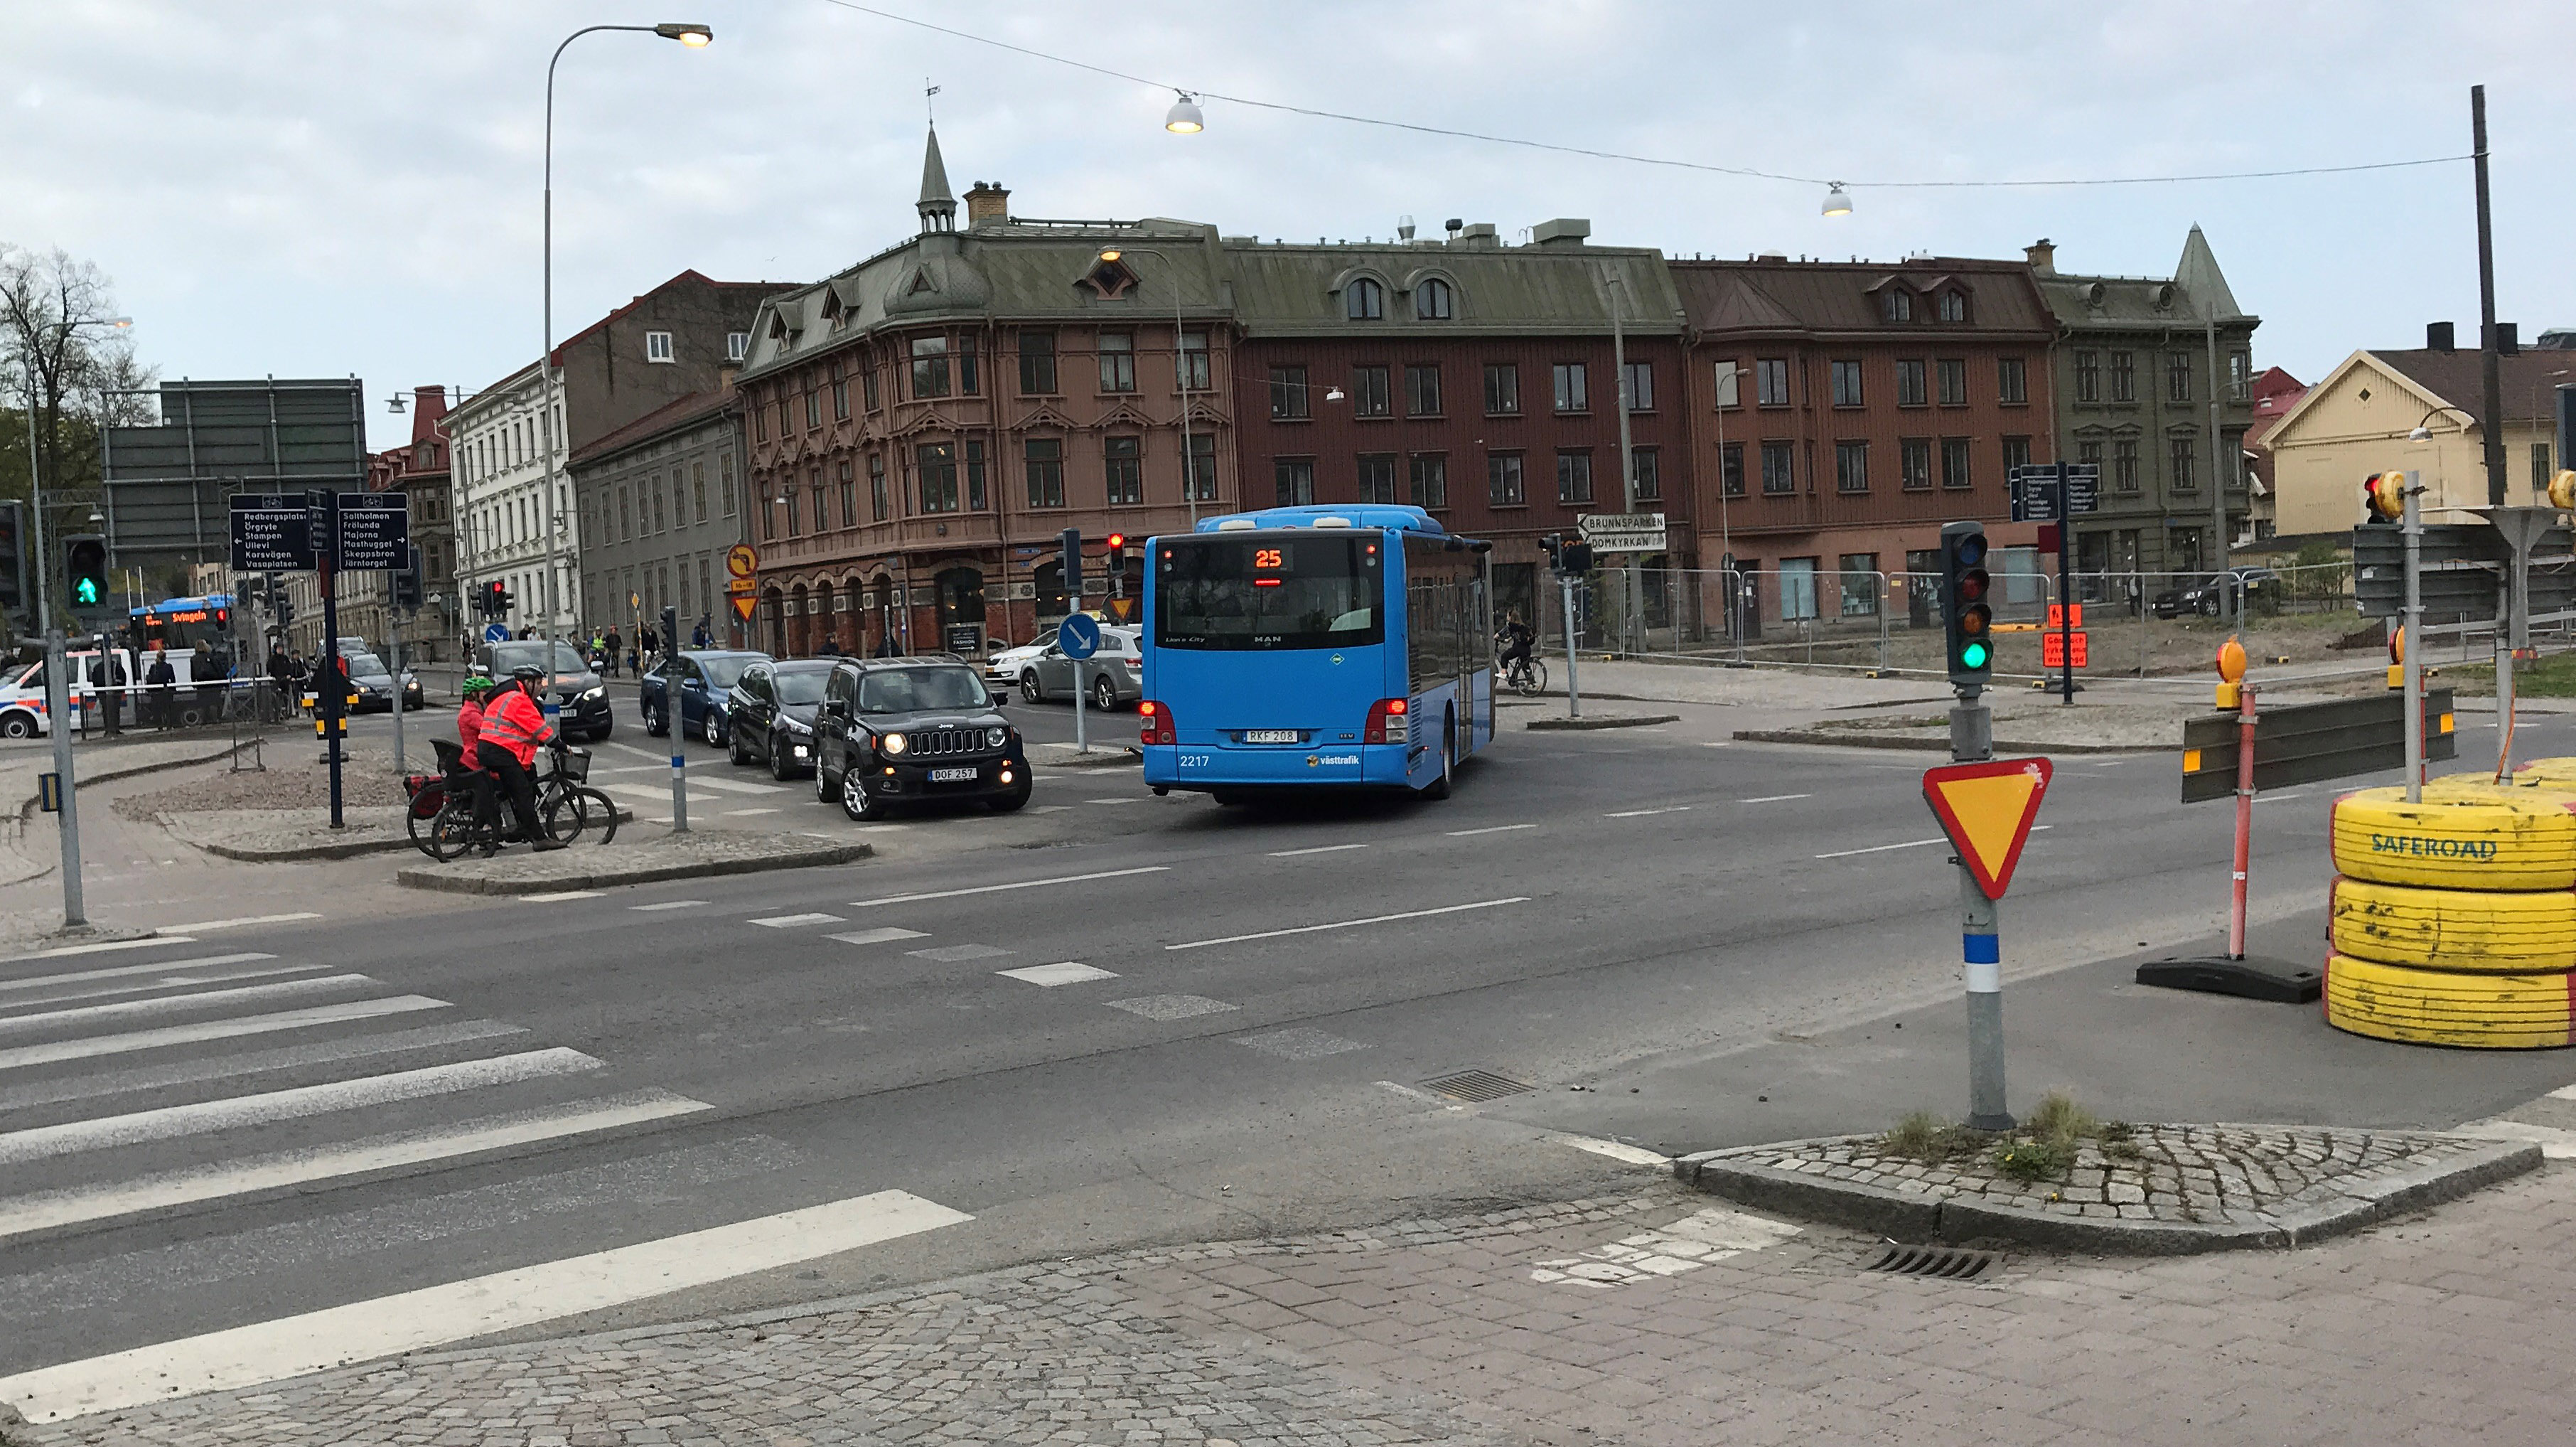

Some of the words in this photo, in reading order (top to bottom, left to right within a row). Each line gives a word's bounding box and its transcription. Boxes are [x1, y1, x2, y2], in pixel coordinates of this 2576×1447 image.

[244, 513, 306, 521] Redbergsplats
[245, 521, 278, 531] Örgryte
[1589, 518, 1663, 528] BRUNNSPARKEN
[245, 532, 282, 540] Stampen
[344, 531, 378, 540] Majorna
[344, 540, 392, 549] Masthugget
[1592, 538, 1648, 548] DOMKYRKAN
[245, 551, 291, 560] Korsvägen
[1256, 550, 1282, 567] 25
[345, 560, 387, 568] Järntorget
[1250, 731, 1269, 741] RKF
[1273, 731, 1294, 741] 208
[1180, 755, 1209, 767] 2217
[1320, 754, 1359, 765] västtrafik
[935, 770, 952, 779] DOF
[955, 769, 973, 779] 257
[2371, 833, 2497, 859] SAFEROAD
